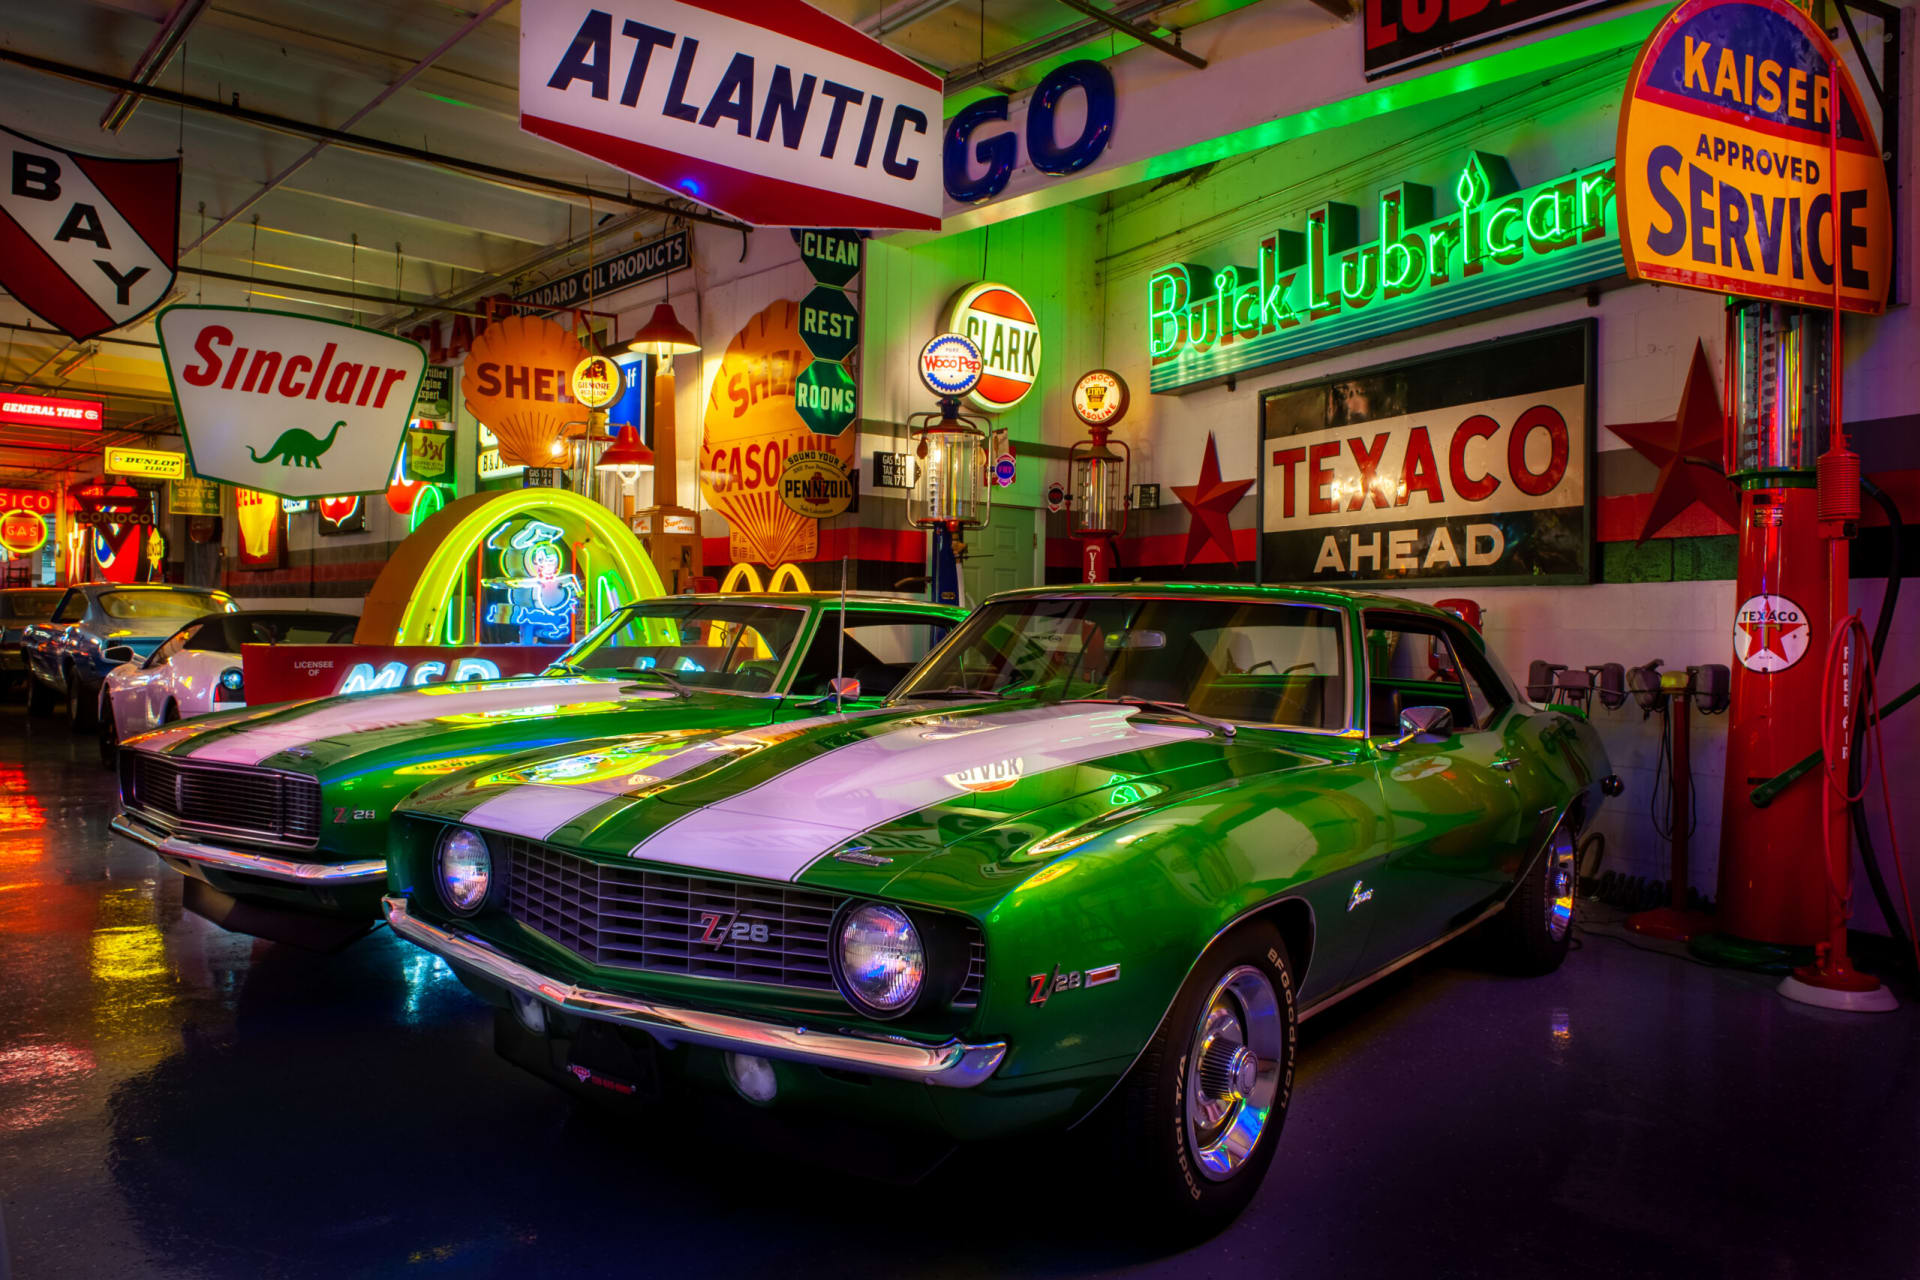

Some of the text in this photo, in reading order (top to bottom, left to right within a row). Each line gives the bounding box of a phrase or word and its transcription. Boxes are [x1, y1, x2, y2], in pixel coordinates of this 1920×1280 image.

[547, 9, 928, 181] ATLANTIC
[1684, 36, 1836, 124] KAISER
[943, 59, 1115, 205] GO
[1696, 134, 1820, 185] APPROVED
[12, 150, 151, 305] BAY
[1646, 145, 1869, 290] SERVICE
[582, 268, 605, 292] OIL
[609, 237, 682, 284] PRODUCTS
[804, 232, 858, 267] CLEAN
[804, 307, 854, 340] REST
[1148, 262, 1300, 366] Buick
[183, 325, 407, 408] Sinclair
[958, 355, 981, 373] Pep
[477, 362, 582, 404] SHEL
[1079, 374, 1115, 389] CONOCO
[2, 402, 55, 417] GENERAL
[57, 408, 83, 419] TIRE
[797, 382, 856, 414] ROOMS
[1078, 402, 1117, 421] GASOLINE
[125, 456, 180, 467] DUNLOP
[787, 451, 816, 465] SOUND
[818, 451, 840, 465] YOUR
[882, 454, 893, 465] GAS
[883, 465, 893, 475] TAX
[1273, 404, 1570, 518] TEXACO
[177, 488, 215, 500] STATE
[785, 480, 851, 498] PENNZOIL
[78, 512, 150, 524] CONOCO
[173, 501, 203, 509] MOTOR
[6, 526, 37, 537] GAS
[1313, 523, 1505, 573] AHEAD
[1088, 552, 1097, 583] VIS
[1742, 611, 1799, 622] TEXACO
[294, 661, 334, 669] LICENSEE
[308, 669, 320, 677] OF
[701, 910, 769, 951] Z/28
[1030, 963, 1081, 1007] Z/28
